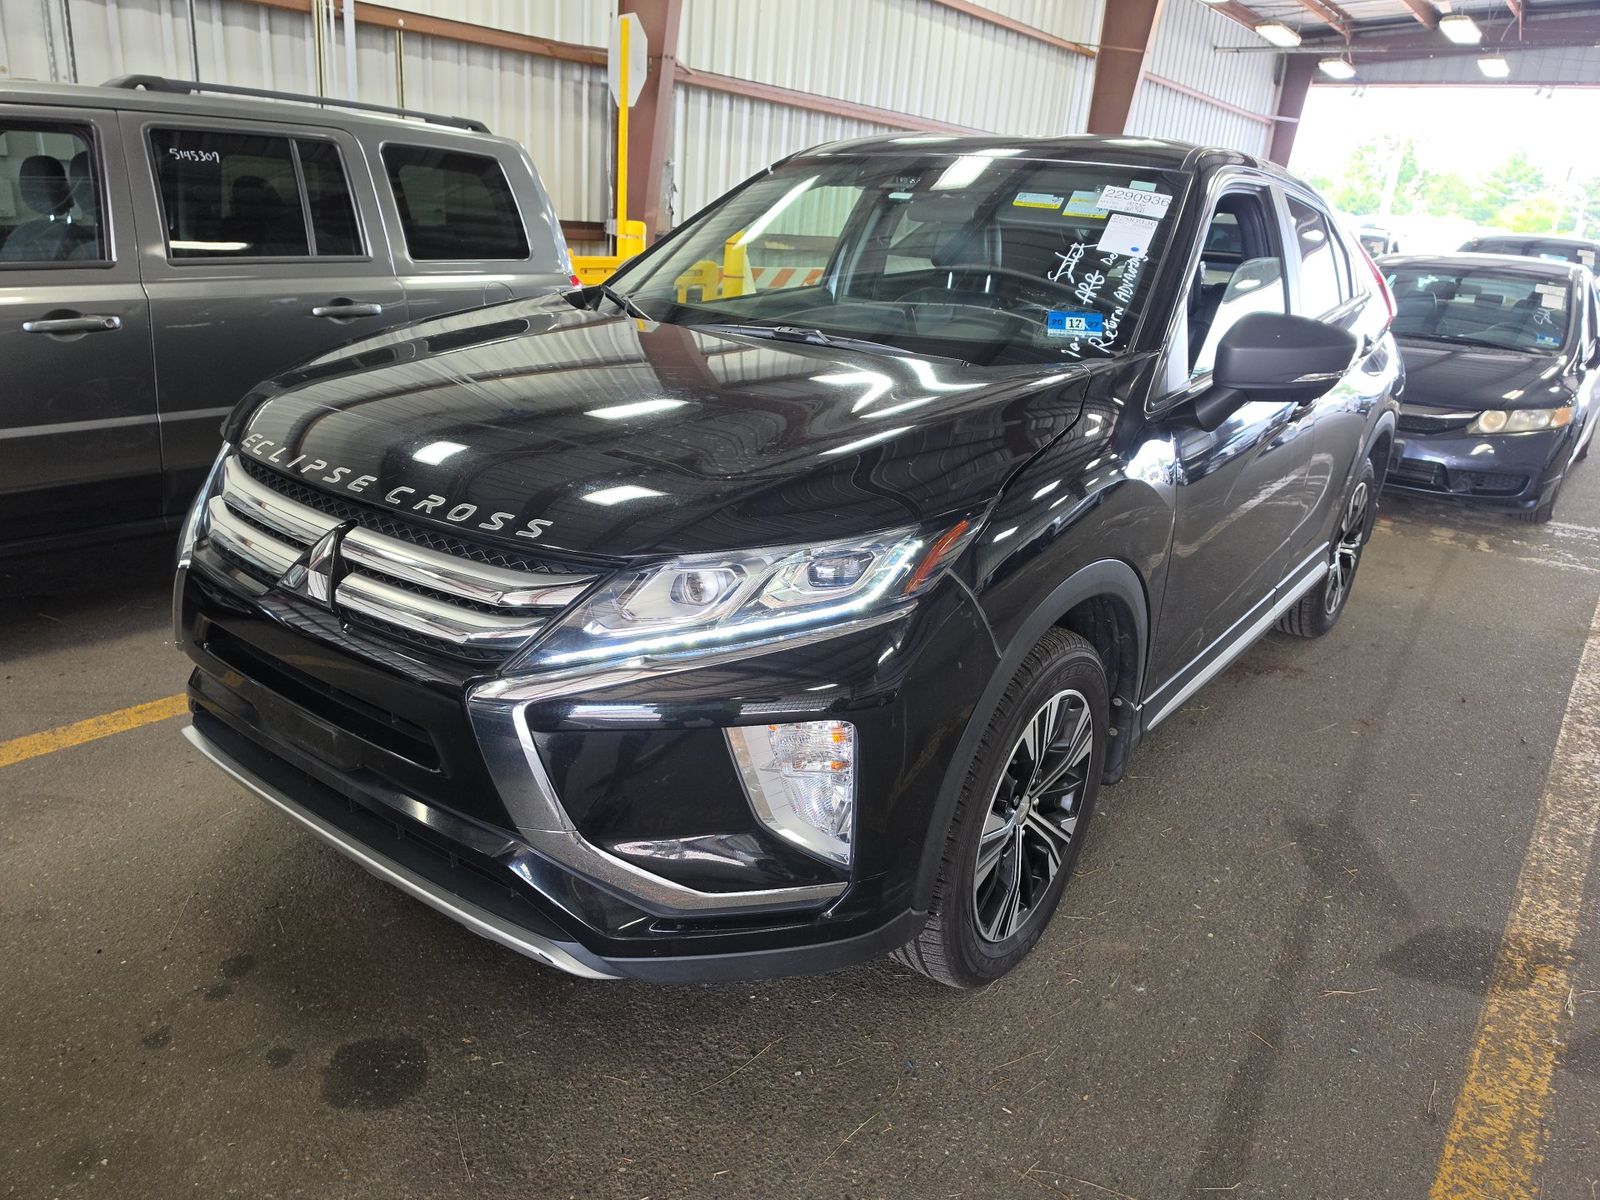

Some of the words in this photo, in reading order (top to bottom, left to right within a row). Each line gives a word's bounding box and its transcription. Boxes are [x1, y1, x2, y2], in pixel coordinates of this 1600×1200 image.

[1104, 188, 1171, 207] 2290936
[1068, 318, 1083, 329] 12
[240, 432, 378, 493] ECLIPSE
[384, 485, 555, 539] CROSS
